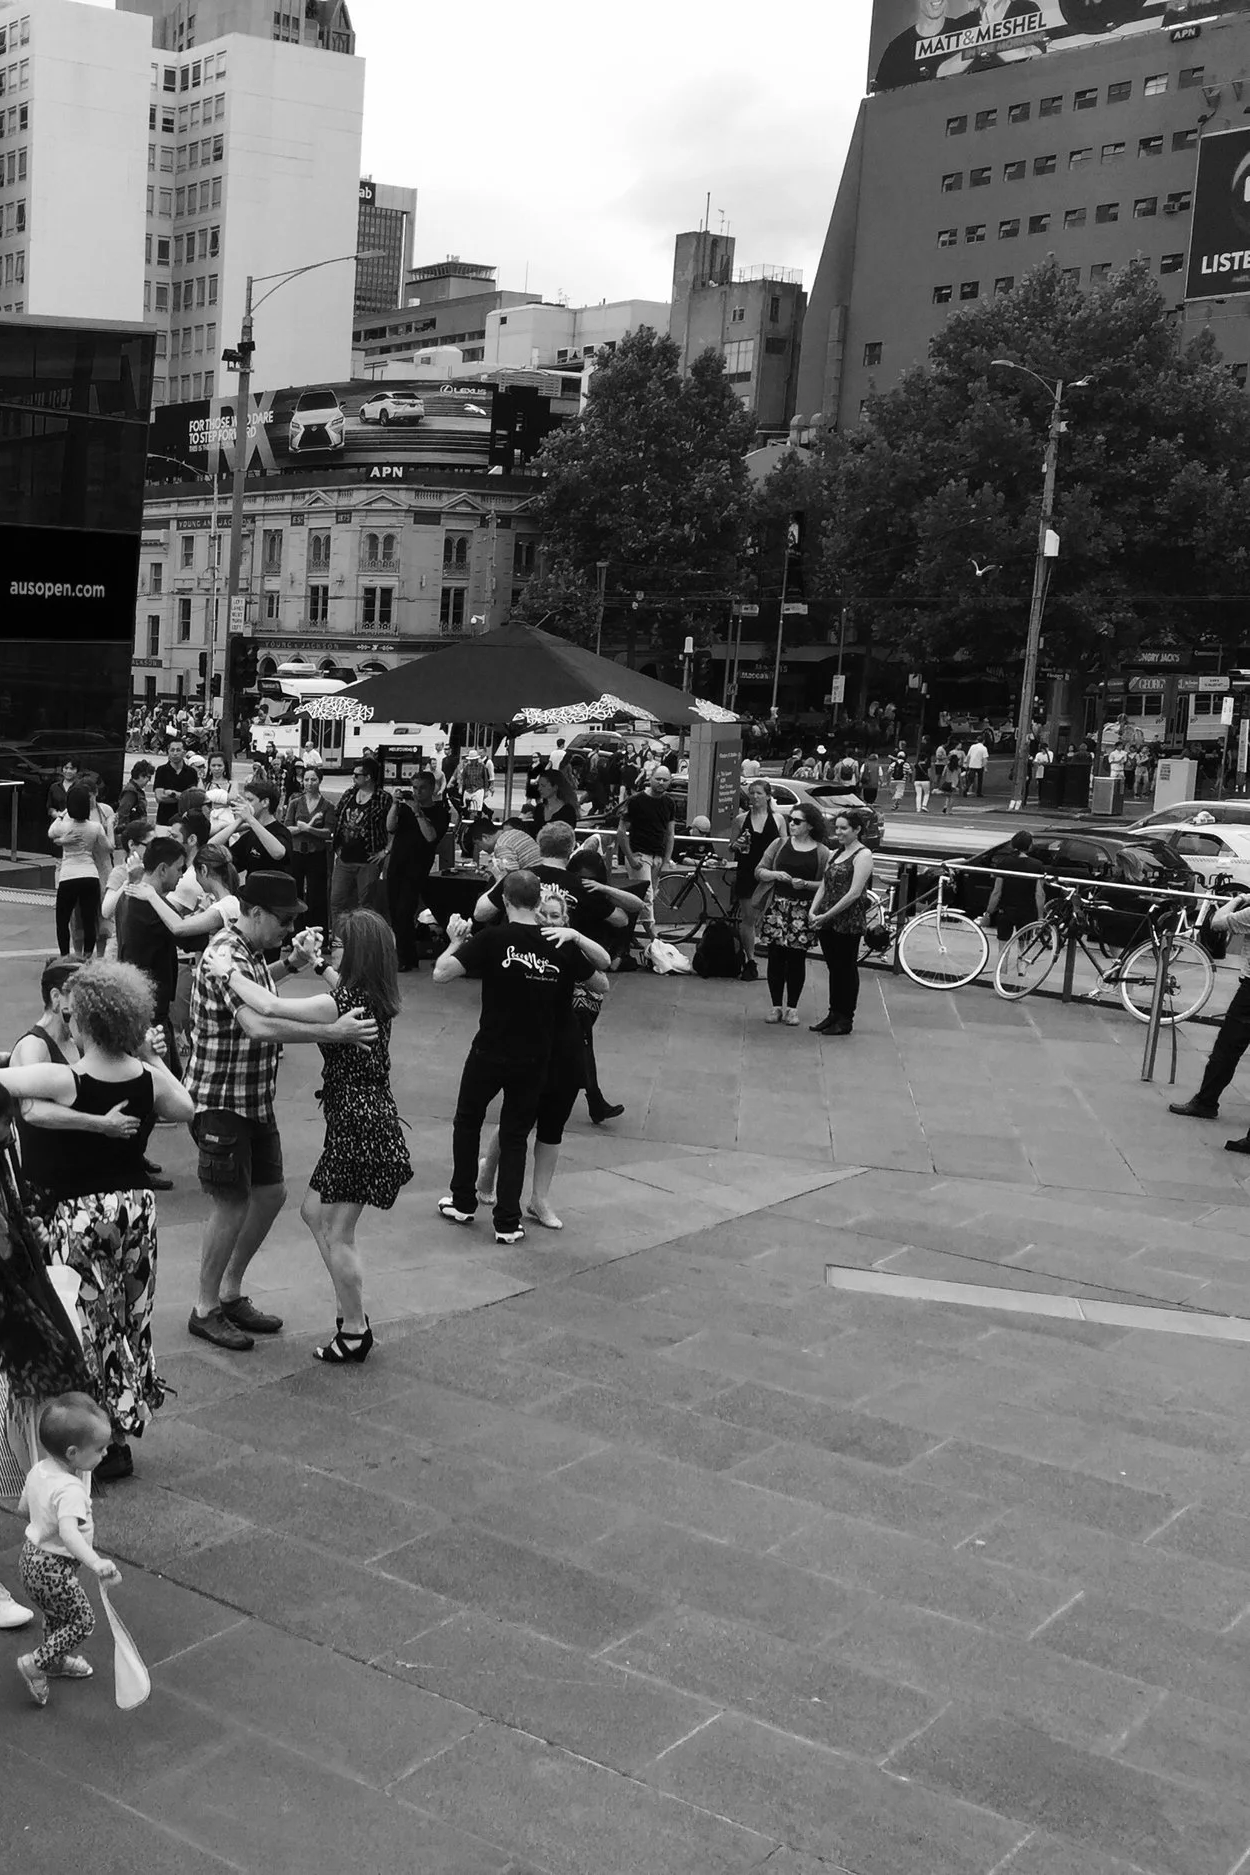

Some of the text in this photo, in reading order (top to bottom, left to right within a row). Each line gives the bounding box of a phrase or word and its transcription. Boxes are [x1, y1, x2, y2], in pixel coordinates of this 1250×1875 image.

[1173, 27, 1197, 41] APN
[453, 387, 487, 396] LEXUS
[188, 419, 205, 433] FOR
[205, 415, 231, 431] THOSE
[252, 411, 275, 426] DARE
[188, 432, 200, 445] TO
[200, 430, 218, 444] STEP
[369, 466, 403, 478] APN
[9, 580, 105, 599] ausopen.com
[301, 642, 339, 650] JACKSON
